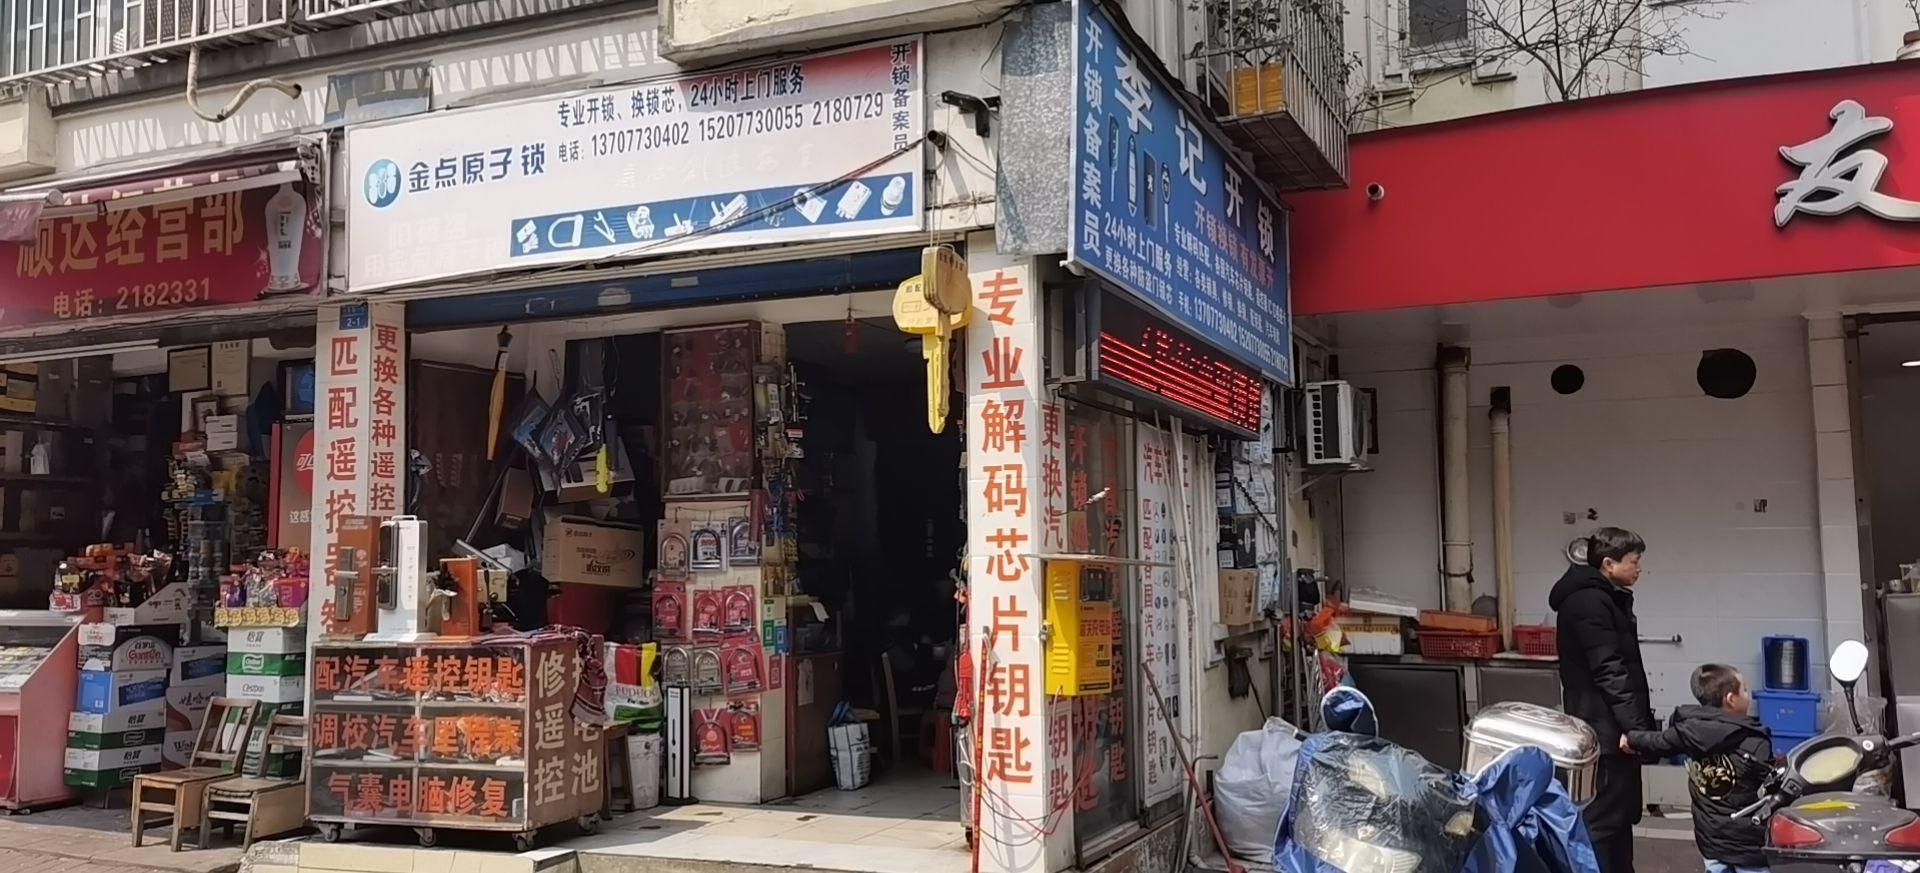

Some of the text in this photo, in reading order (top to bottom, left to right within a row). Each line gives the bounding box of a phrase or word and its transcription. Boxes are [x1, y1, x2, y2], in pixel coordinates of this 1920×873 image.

[699, 104, 804, 143] 15207730055
[813, 92, 884, 127] 2180729
[891, 44, 911, 151] 开锁备案员
[1083, 16, 1102, 258] 开锁备案员
[1114, 47, 1274, 262] 李记开锁
[1775, 99, 1920, 227] 友
[16, 191, 245, 278] 顺达经营部
[369, 323, 398, 520] 更换各种遥控
[979, 271, 1033, 784] 专业解码芯片钥匙
[314, 655, 523, 694] 配汽车遥控钥匙
[534, 651, 566, 806] 修遥控
[312, 712, 523, 756] 调校汽车里程表
[328, 770, 508, 818] 气囊电脑修复
